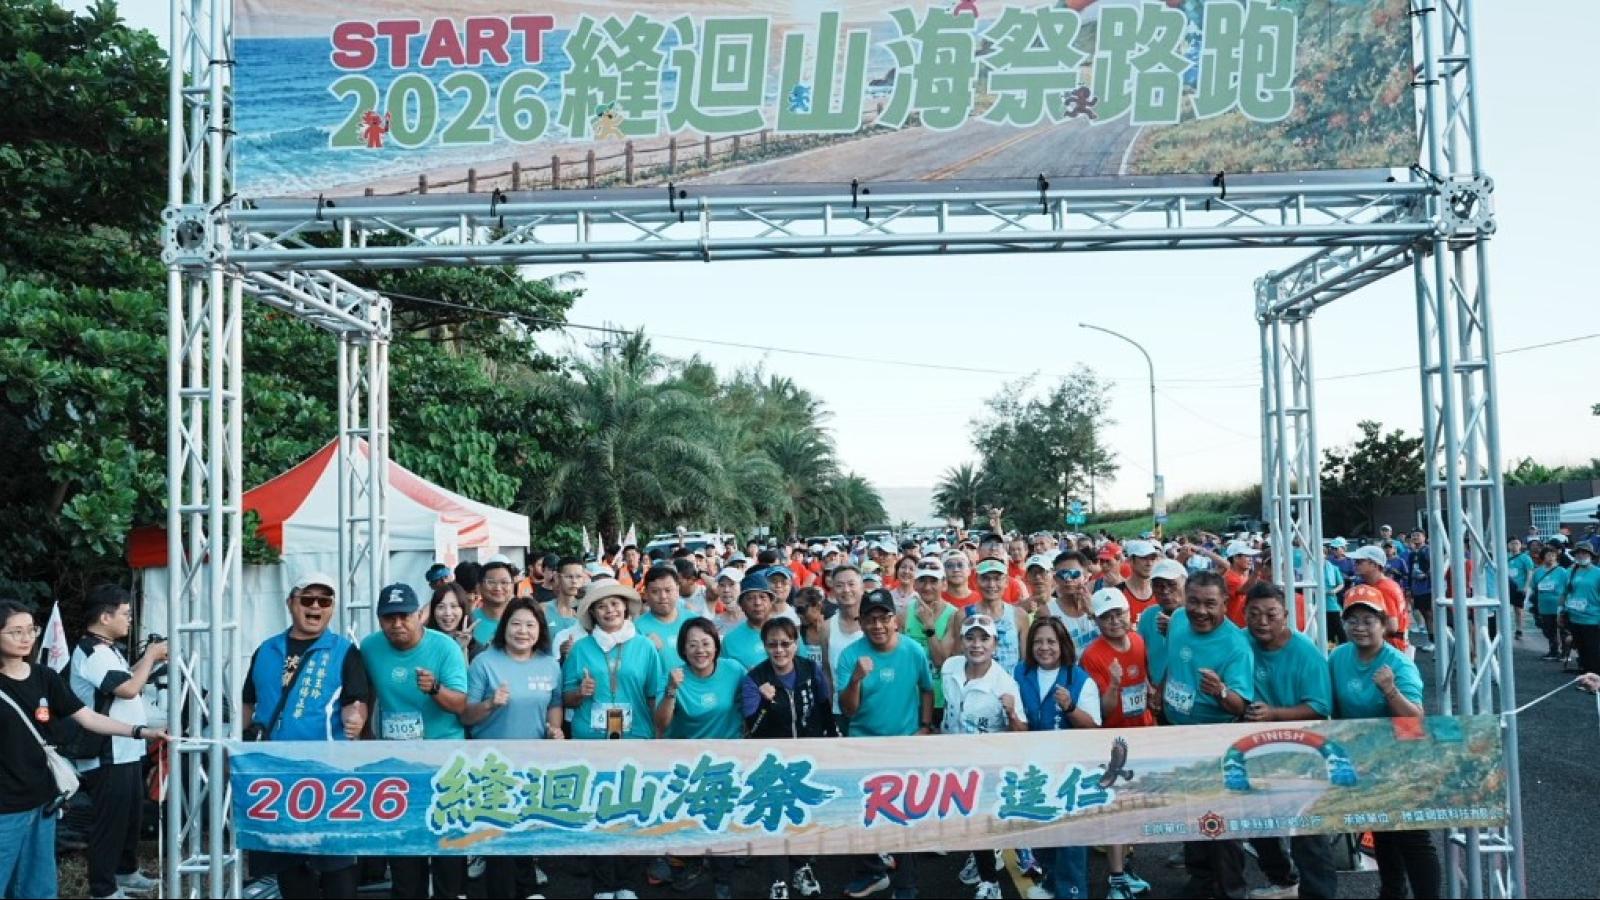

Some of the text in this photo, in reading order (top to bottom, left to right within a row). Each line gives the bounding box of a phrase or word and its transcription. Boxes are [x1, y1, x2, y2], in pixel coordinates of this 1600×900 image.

[330, 0, 1296, 148] 2026 縫迴山海祭路跑
[333, 17, 552, 68] START
[1252, 730, 1305, 743] FINISH
[246, 753, 1110, 831] 2026 縫迴山海祭 RUN 達仁
